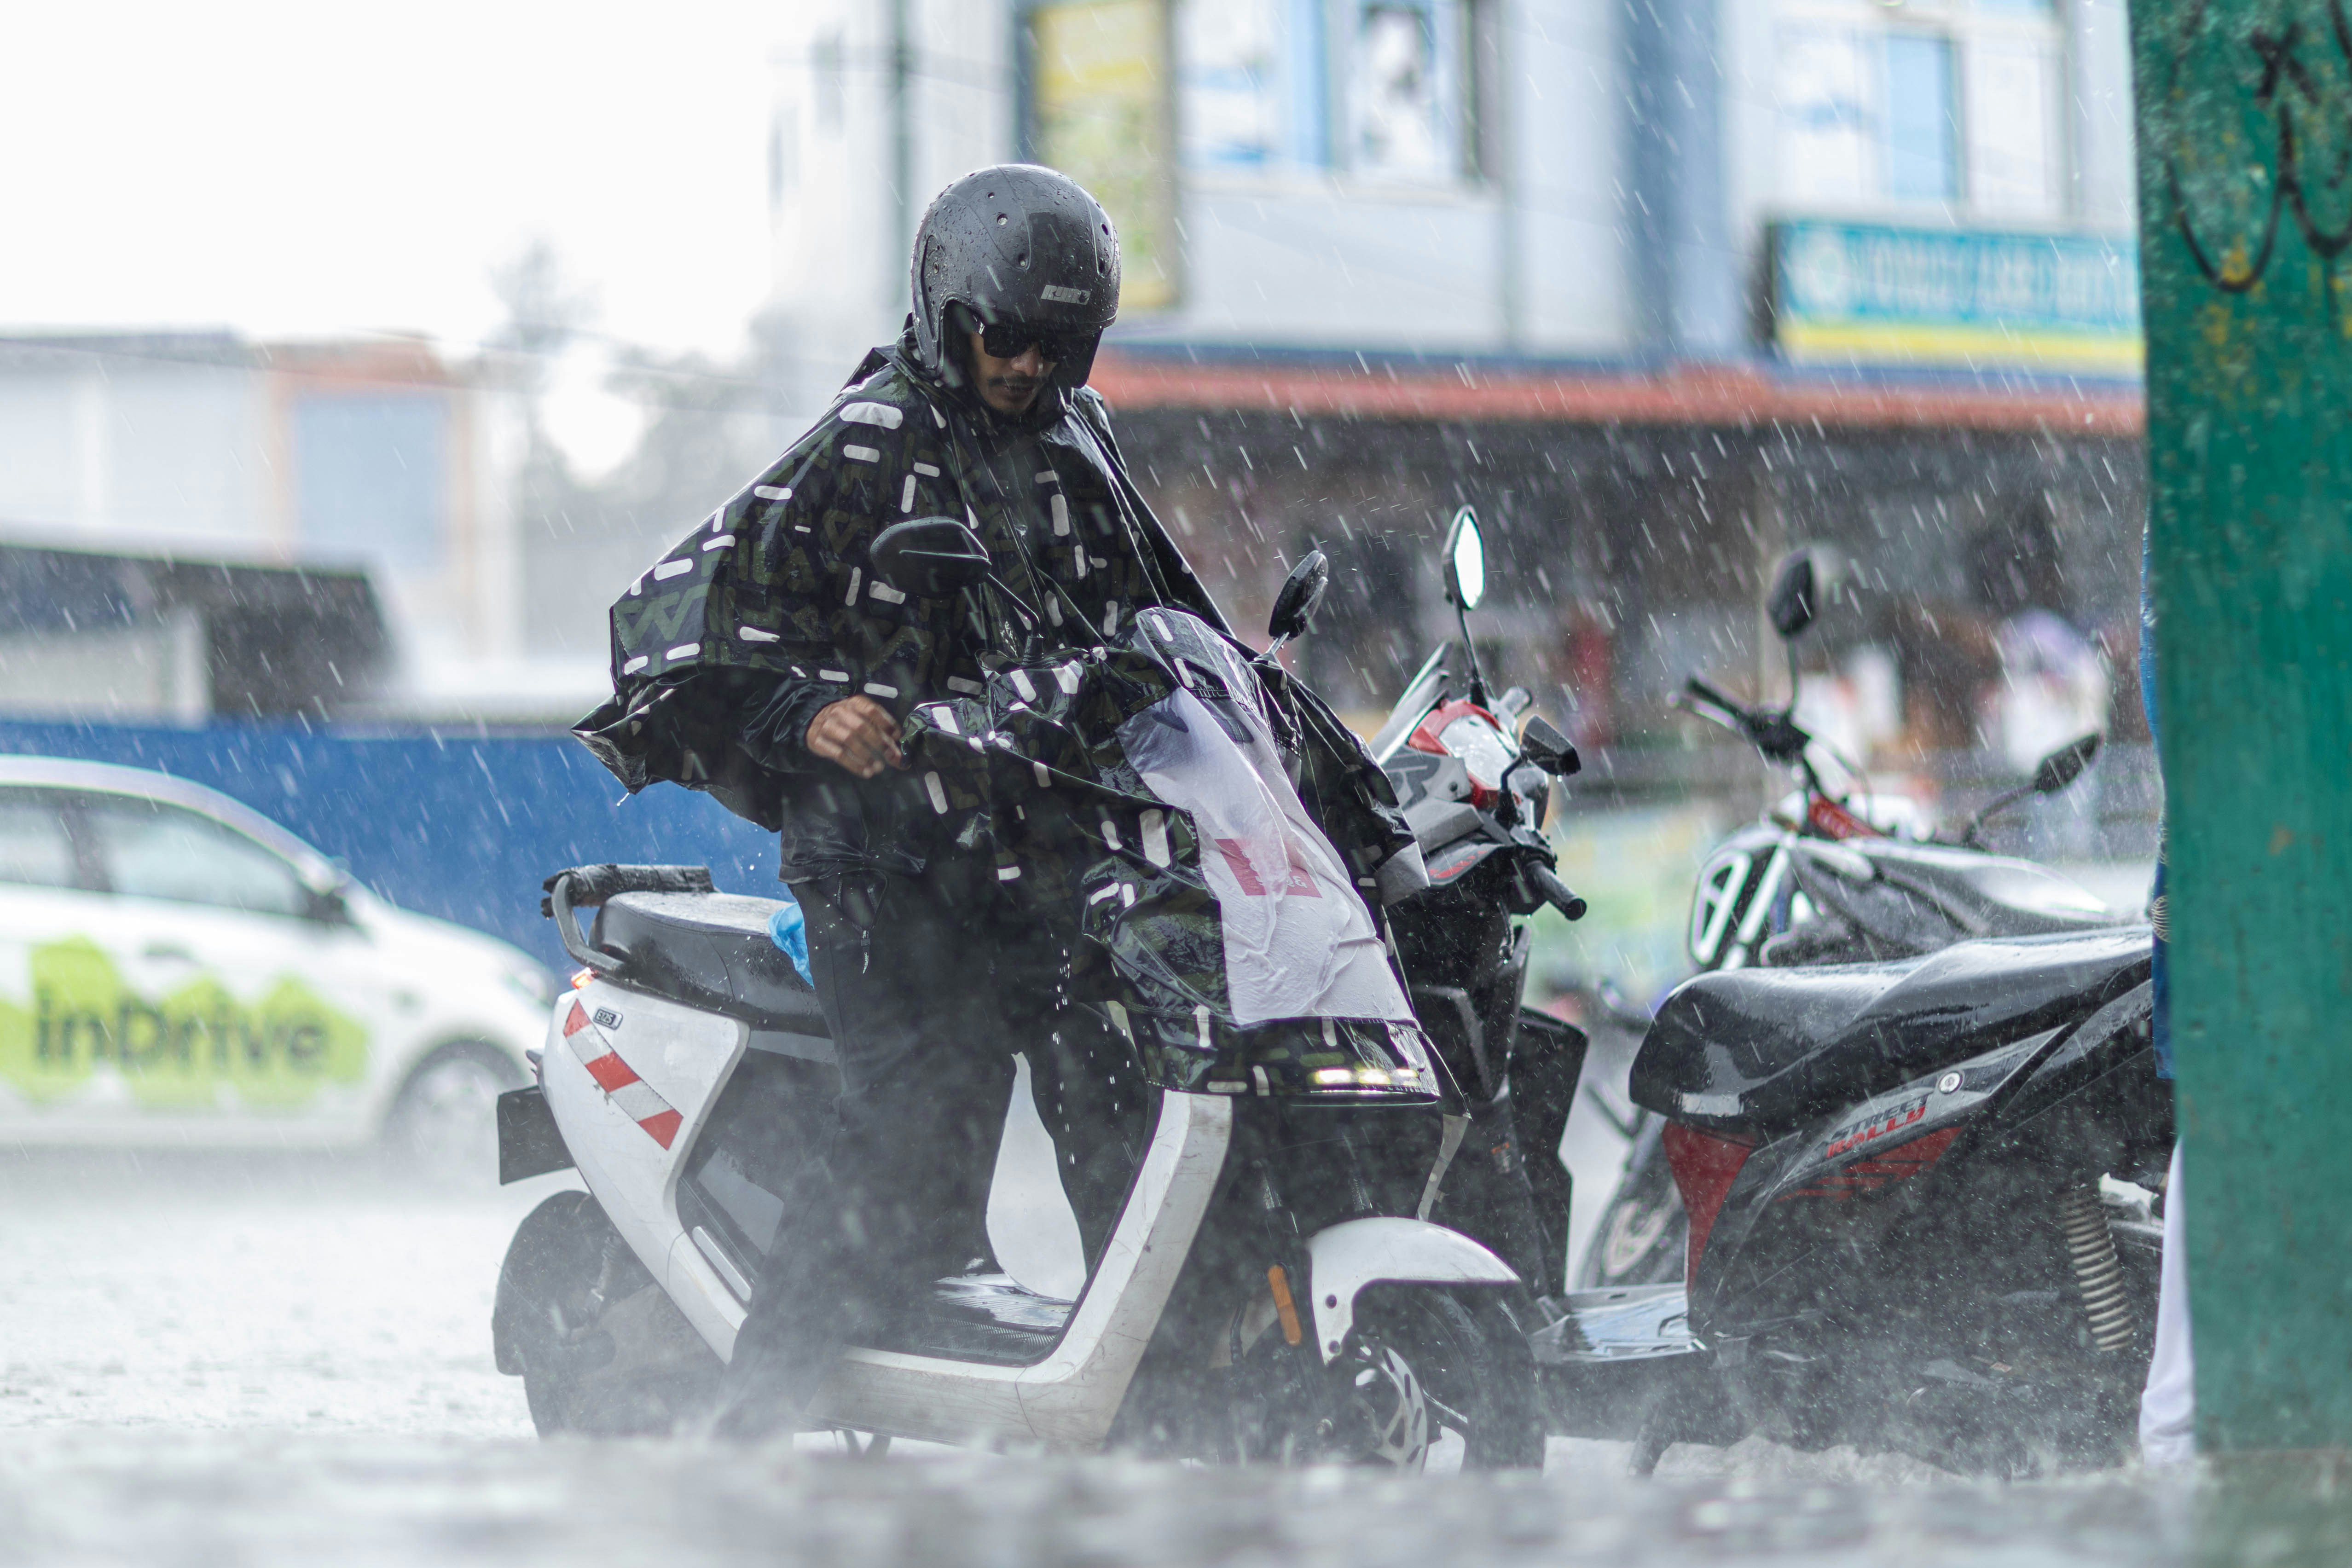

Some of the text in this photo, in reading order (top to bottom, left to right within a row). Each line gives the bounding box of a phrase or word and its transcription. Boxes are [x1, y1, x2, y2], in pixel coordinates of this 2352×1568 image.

[36, 988, 330, 1071] inDrive
[1826, 1105, 1926, 1158] RALLY
[1831, 1091, 1934, 1142] STREET
